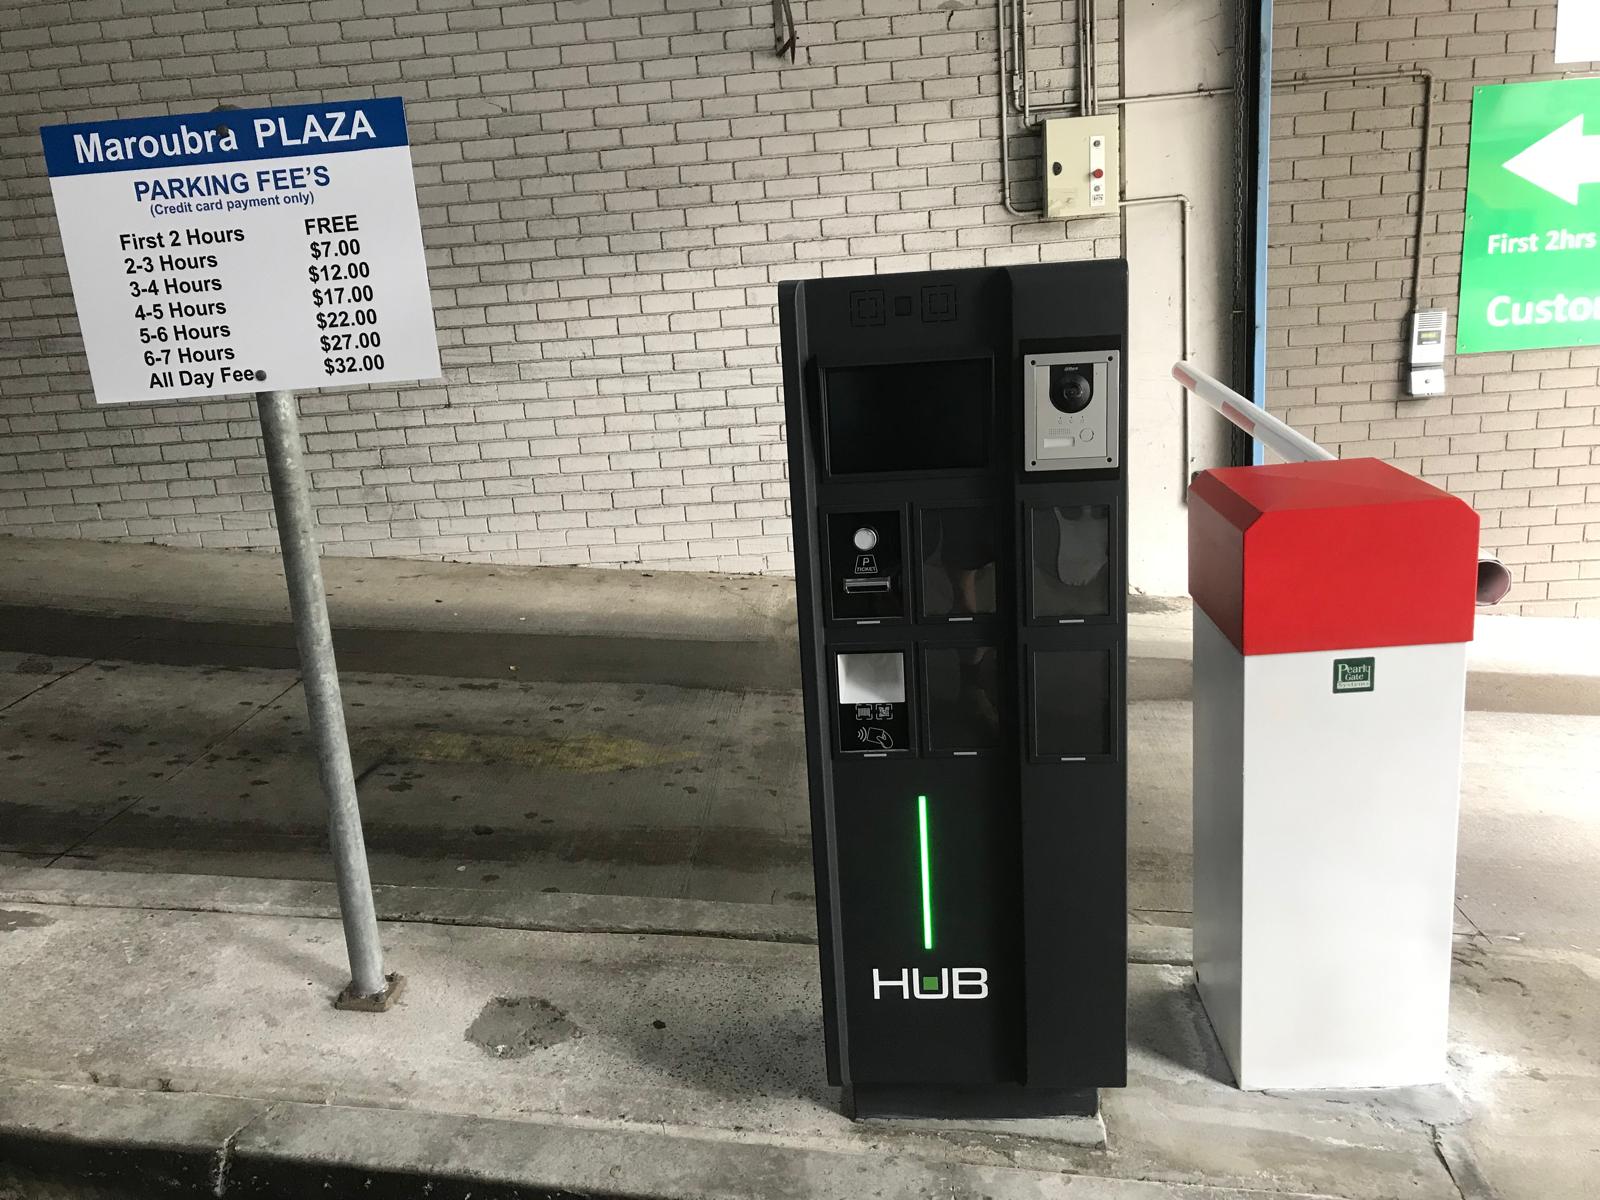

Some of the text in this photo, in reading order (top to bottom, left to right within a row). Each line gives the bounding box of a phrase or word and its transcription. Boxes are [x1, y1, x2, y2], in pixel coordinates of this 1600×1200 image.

[73, 110, 377, 164] Maroubra PLAZA
[134, 165, 331, 202] PARKING FEE'S
[150, 191, 315, 218] (Credit card payment only)
[119, 214, 359, 251] First 2 Hours FREE
[1487, 228, 1597, 255] First 2hrs
[124, 238, 361, 274] 2-3 Hours $7.00
[129, 261, 370, 297] 3-4 Hours $12.00
[134, 284, 374, 321] 4-5 Hours $17.00
[1487, 293, 1600, 327] Custo
[139, 308, 377, 344] 5-6 Hours $22.00
[144, 331, 381, 366] 6-7 Hours $27.00
[149, 354, 385, 388] All Day Fee $32.00
[862, 557, 870, 566] P
[1338, 664, 1371, 679] Pearly
[1345, 673, 1364, 681] Gate
[872, 967, 989, 999] HUB
